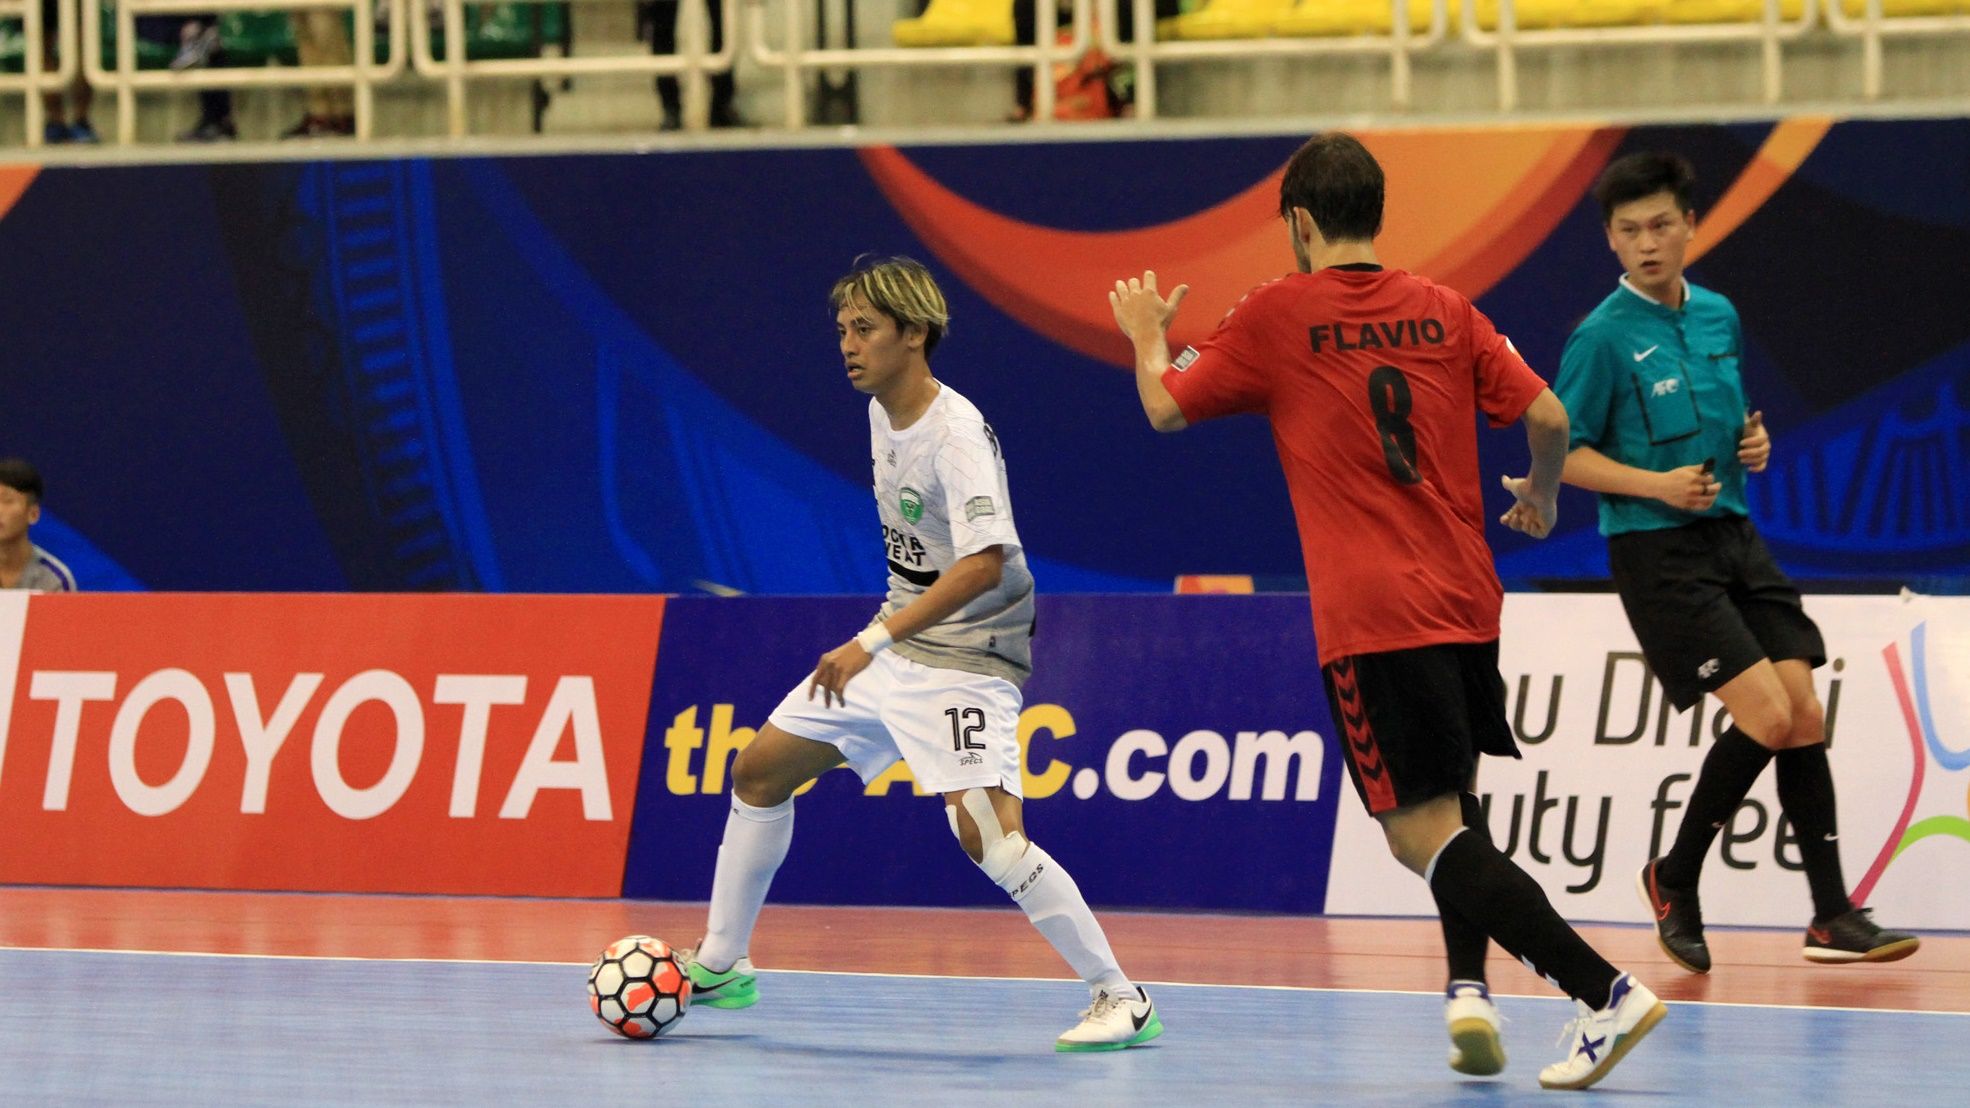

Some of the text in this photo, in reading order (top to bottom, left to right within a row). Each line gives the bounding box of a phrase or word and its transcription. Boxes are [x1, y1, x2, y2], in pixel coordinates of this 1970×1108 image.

[1308, 318, 1445, 353] FLAVIO
[1367, 365, 1423, 485] 8
[29, 667, 614, 821] TOYOTA
[945, 706, 987, 751] 12
[1481, 769, 1809, 895] uty fee
